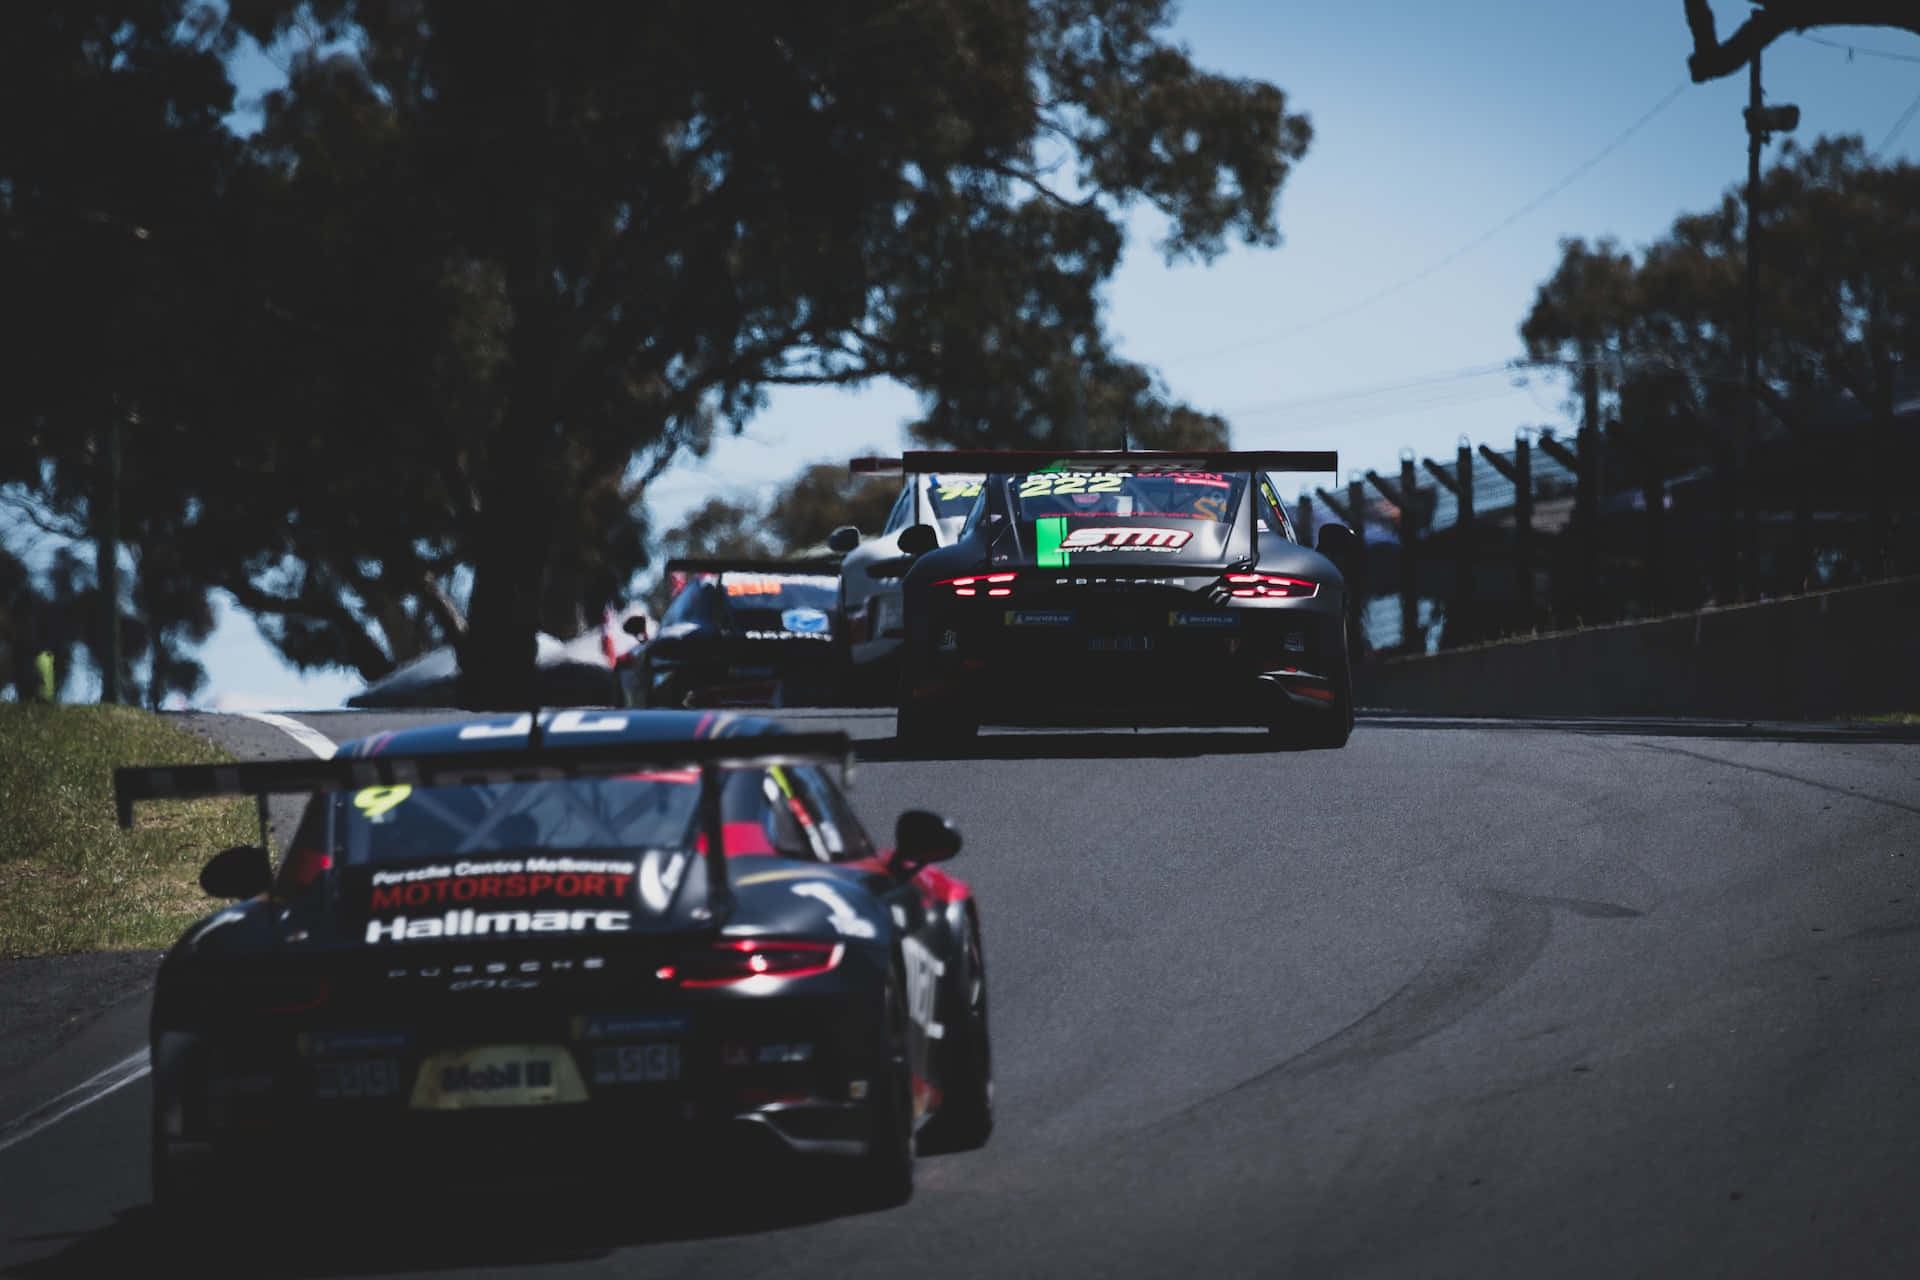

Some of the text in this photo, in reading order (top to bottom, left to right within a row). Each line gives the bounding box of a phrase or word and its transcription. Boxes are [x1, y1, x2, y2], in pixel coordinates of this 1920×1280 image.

[1018, 475, 1123, 498] 222
[353, 783, 413, 818] 9
[371, 857, 636, 887] Porsche Centre Melbourne
[369, 873, 632, 912] MOTORSPORT
[364, 907, 633, 944] Hallmarc
[386, 956, 606, 977] PORSCHE
[442, 1061, 520, 1091] Mobil
